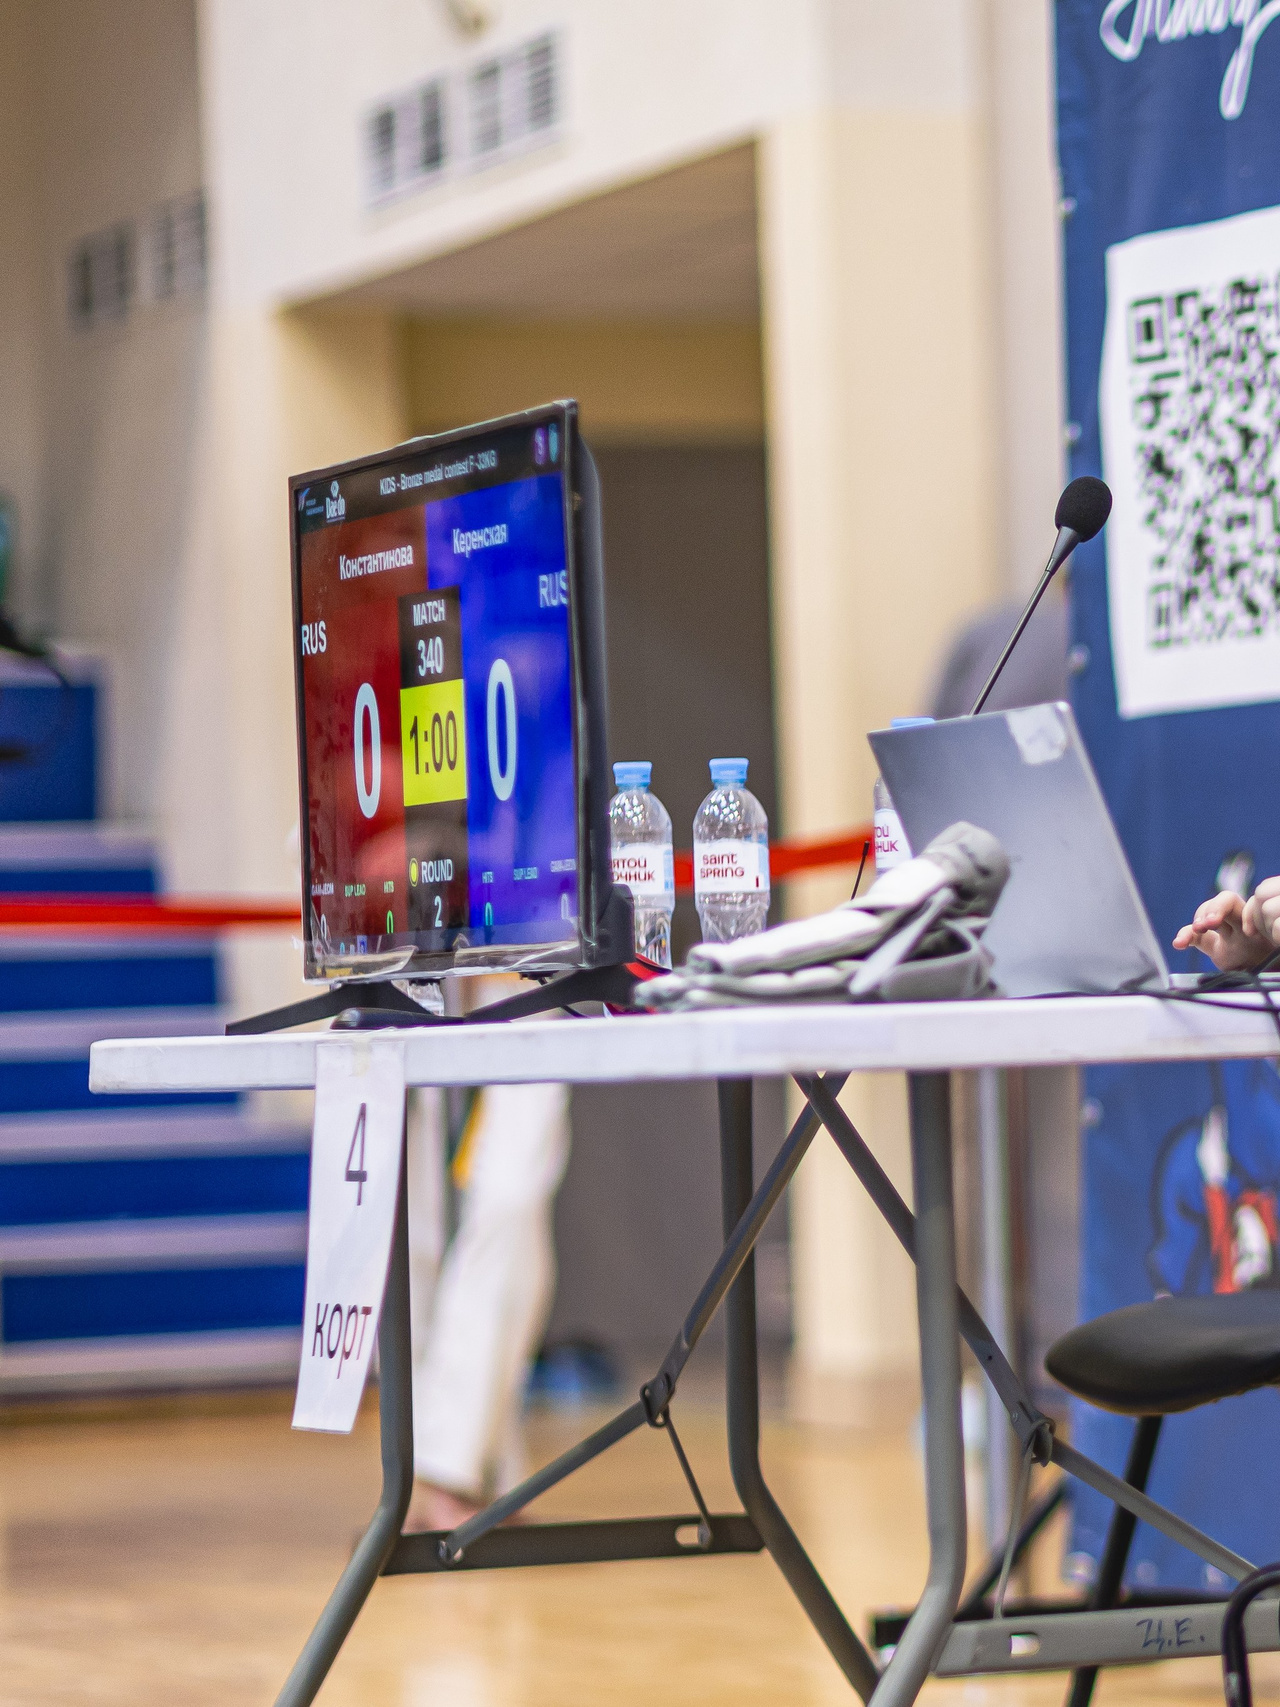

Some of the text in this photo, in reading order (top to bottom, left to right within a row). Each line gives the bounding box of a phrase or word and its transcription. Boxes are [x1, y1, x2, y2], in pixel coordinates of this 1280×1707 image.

[379, 476, 397, 496] KIDS
[400, 473, 424, 490] Bronze
[424, 464, 443, 484] medal
[445, 458, 468, 479] contest
[452, 523, 508, 559] Керенская
[339, 544, 414, 581] Константинова
[538, 570, 568, 609] RUS
[412, 599, 446, 627] MATCH
[301, 620, 327, 656] RUS
[417, 636, 444, 677] 340
[409, 710, 458, 775] 1:00
[486, 658, 517, 801] 0
[354, 682, 381, 819] 0
[421, 858, 453, 883] ROUND
[612, 870, 655, 882] ОЧНИК
[434, 895, 443, 929] 2
[345, 1101, 368, 1207] 4
[311, 1301, 373, 1380] корт
